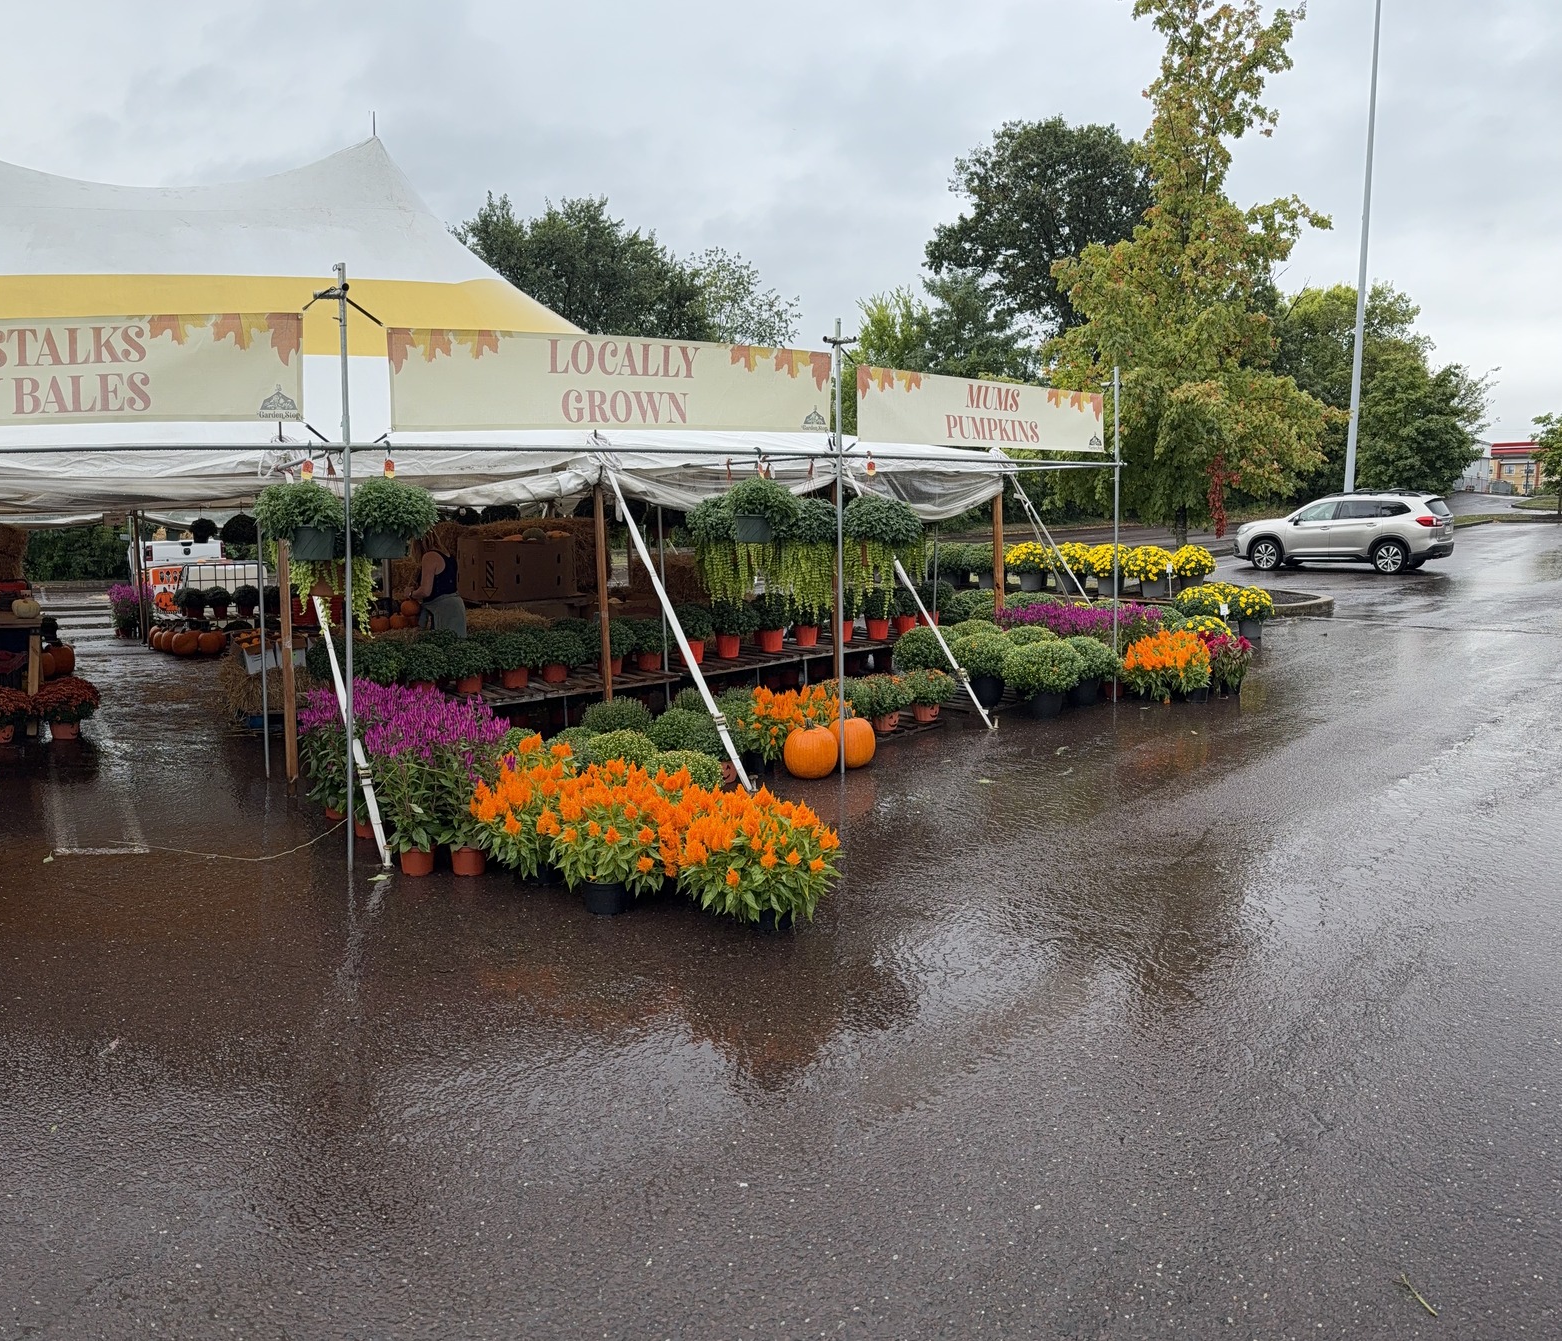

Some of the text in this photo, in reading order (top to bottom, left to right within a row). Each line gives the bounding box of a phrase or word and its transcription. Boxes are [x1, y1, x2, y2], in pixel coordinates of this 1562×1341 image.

[548, 338, 700, 379] LOCALLY
[12, 372, 152, 414] BALES
[561, 388, 689, 424] GROWN
[965, 383, 1020, 413] MUMS
[258, 410, 285, 420] Garden
[945, 413, 1040, 444] PUMPKINS
